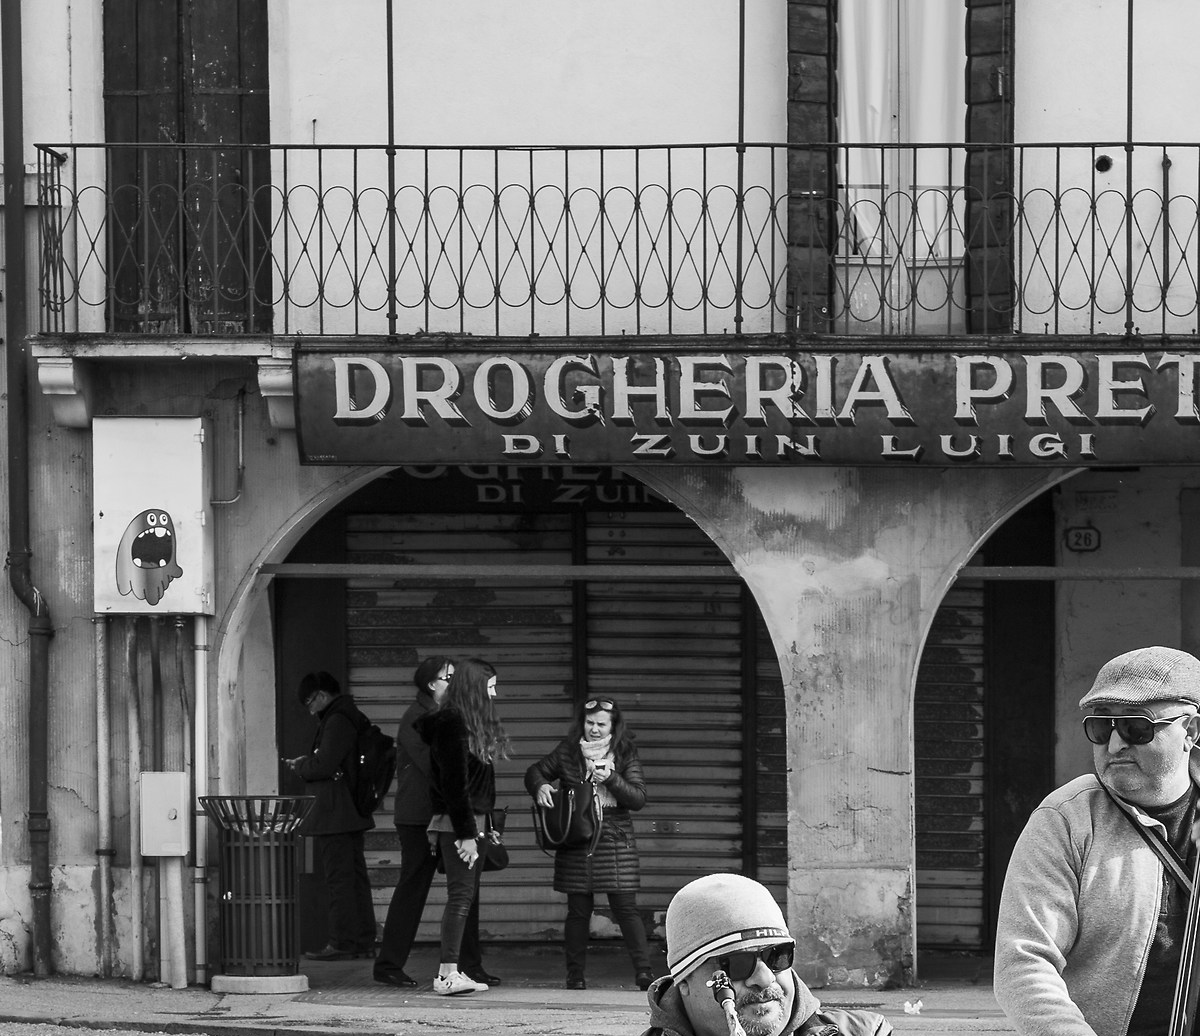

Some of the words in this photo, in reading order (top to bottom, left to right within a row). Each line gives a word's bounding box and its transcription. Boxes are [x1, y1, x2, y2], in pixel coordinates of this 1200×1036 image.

[332, 354, 910, 424] DROGHERIA
[502, 434, 569, 457] DI
[630, 431, 820, 457] ZUIN
[881, 433, 1096, 458] LUIGI
[477, 484, 522, 503] DI
[1074, 532, 1092, 547] 26
